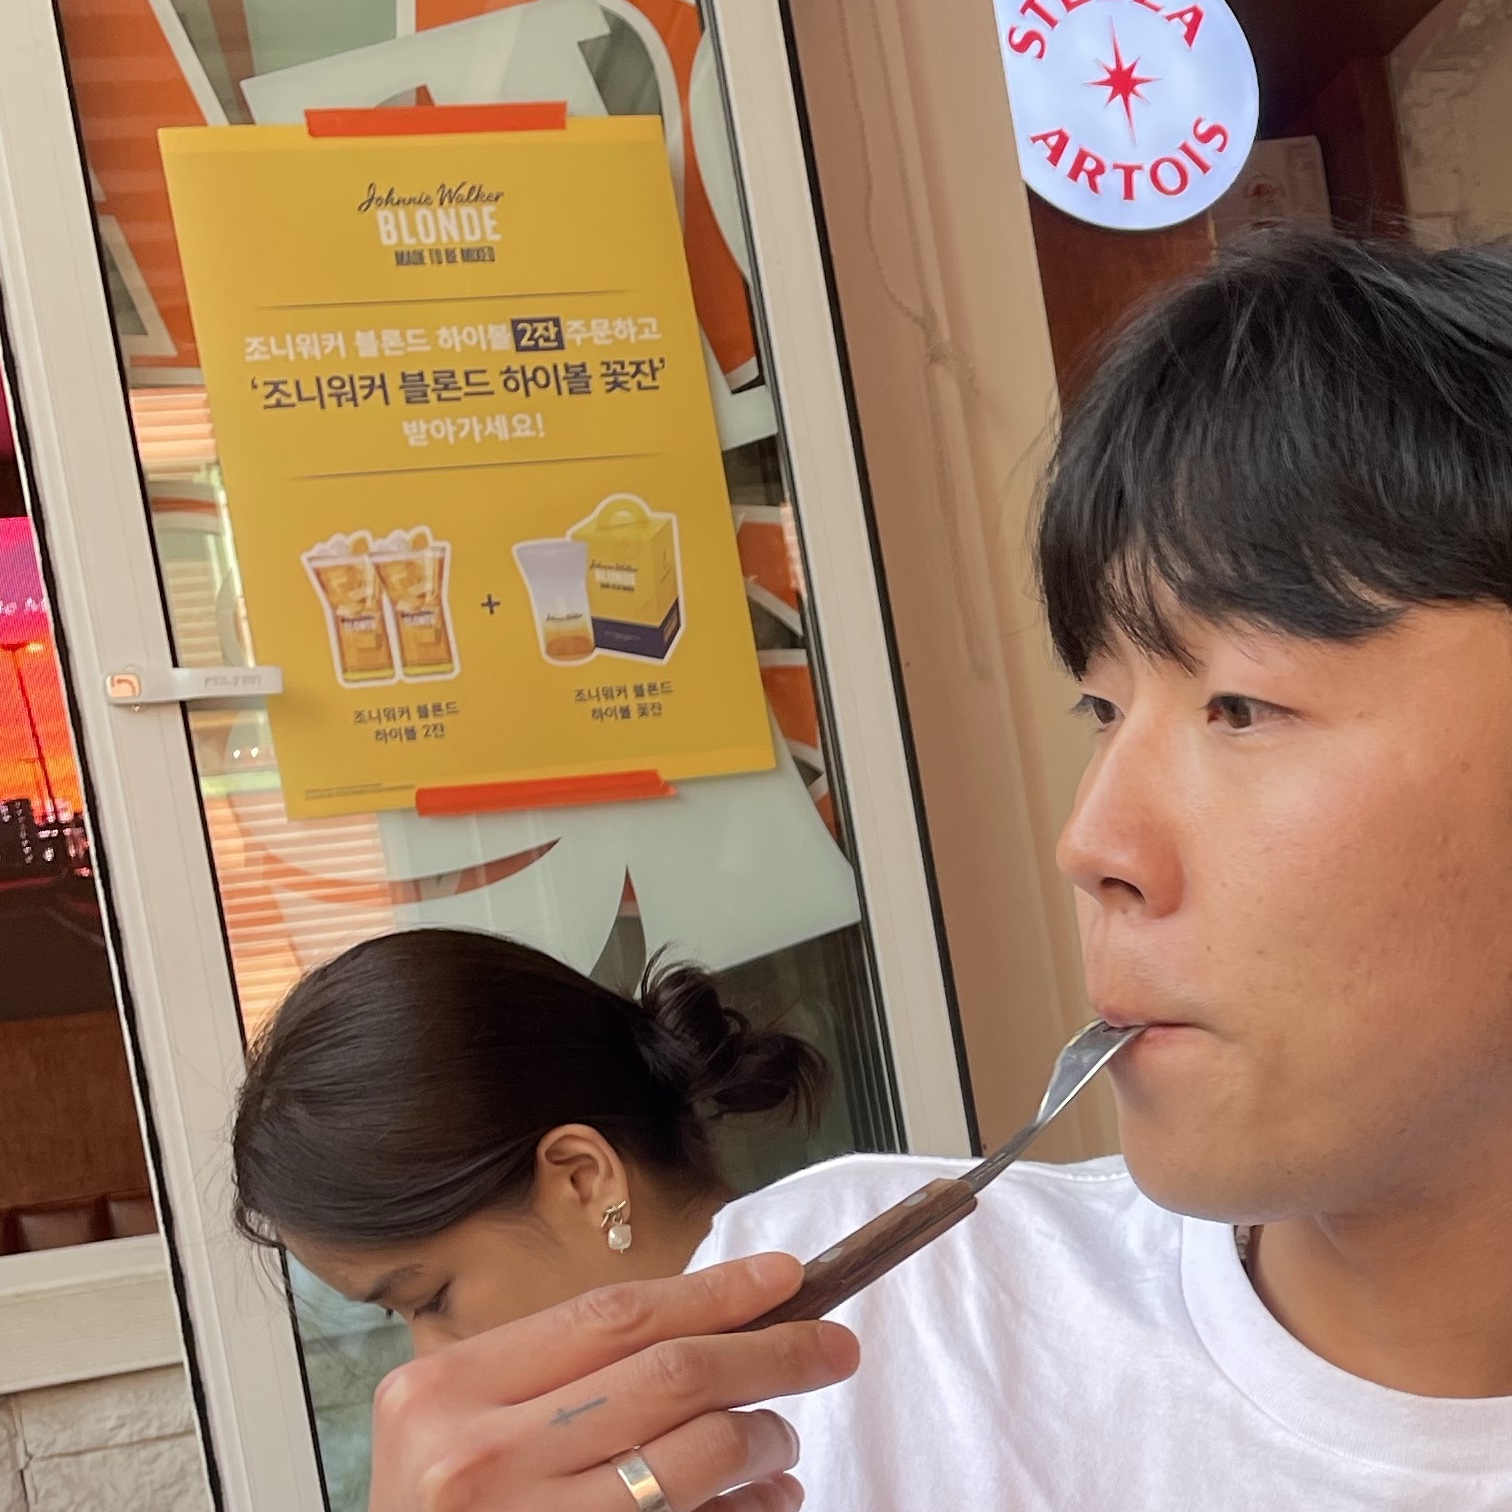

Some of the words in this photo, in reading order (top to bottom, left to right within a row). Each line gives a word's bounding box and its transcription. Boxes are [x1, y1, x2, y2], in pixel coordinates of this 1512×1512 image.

[1029, 114, 1230, 201] ARTOIS
[357, 182, 434, 212] Johnnie
[437, 181, 505, 206] Walker
[376, 205, 502, 247] BLONDE
[244, 331, 347, 362] 조니워커
[355, 327, 432, 359] 블론드
[437, 323, 512, 352] 하이볼
[516, 320, 559, 348] 2잔
[566, 316, 663, 346] 주문하고
[399, 367, 495, 405] 블론드
[500, 360, 593, 398] 하이볼
[402, 412, 546, 448] 받아가세요!
